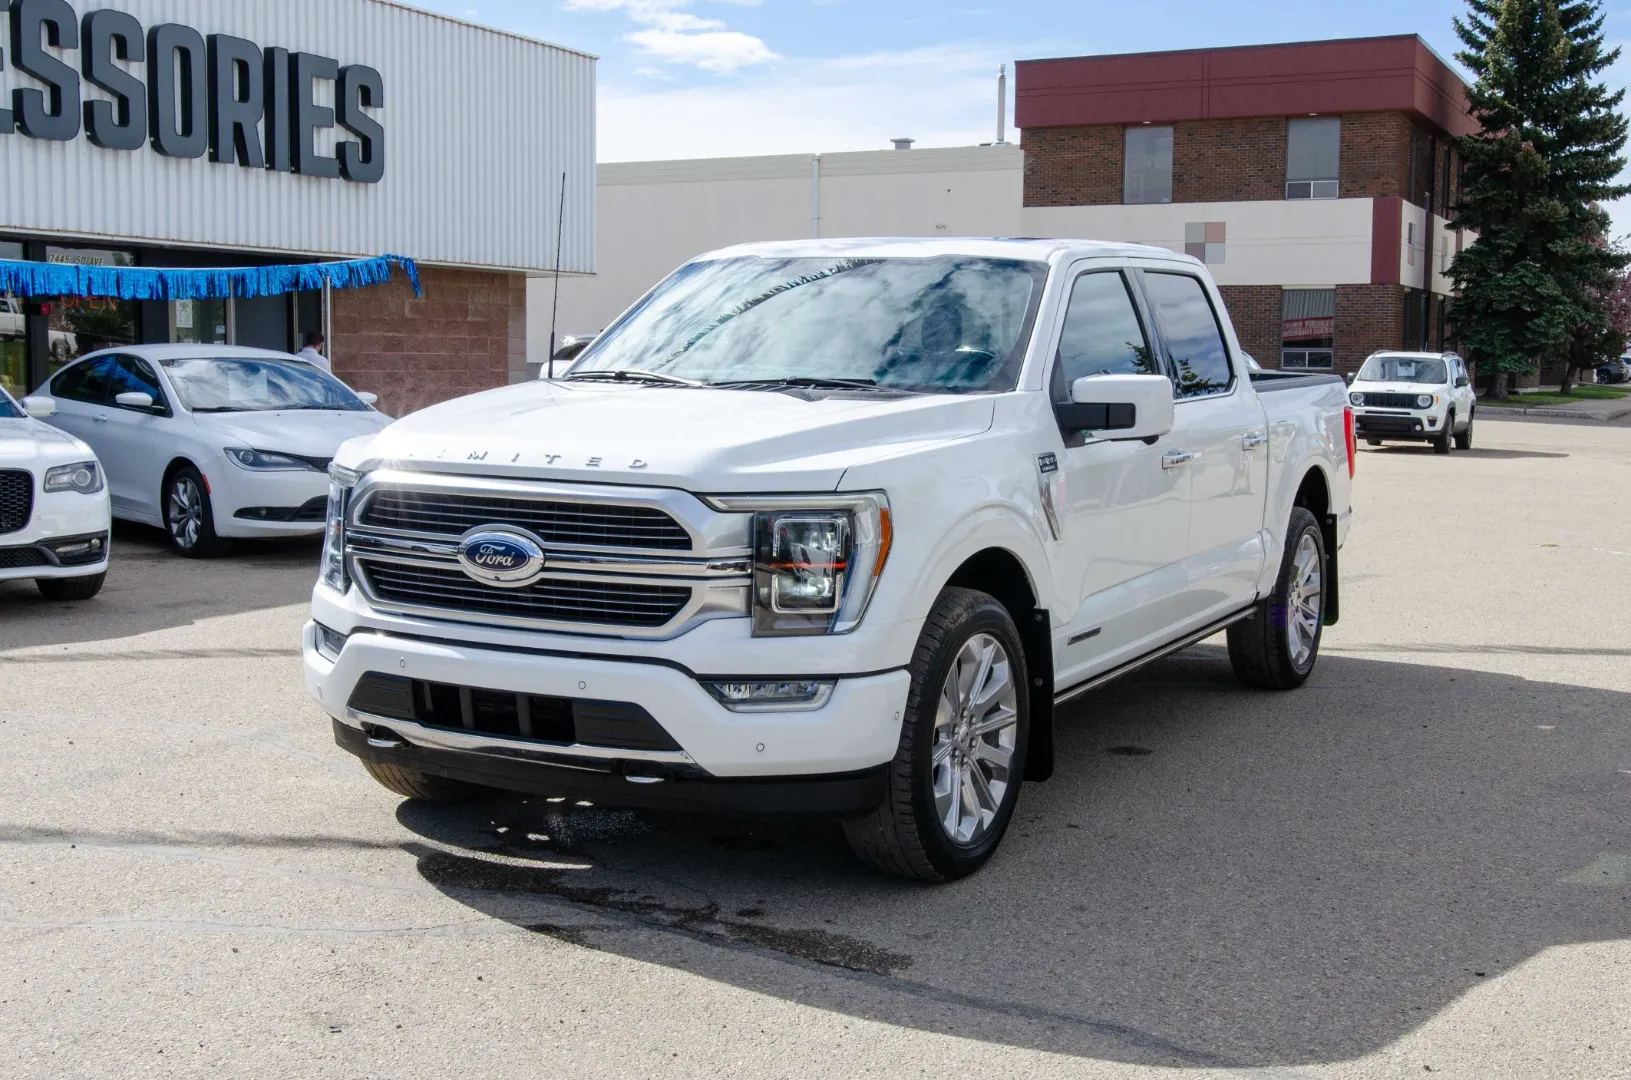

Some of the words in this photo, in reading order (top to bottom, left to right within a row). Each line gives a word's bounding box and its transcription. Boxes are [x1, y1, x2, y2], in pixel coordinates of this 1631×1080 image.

[0, 0, 384, 184] SSORIES
[50, 254, 70, 264] 7445
[89, 256, 104, 266] AVE
[475, 543, 516, 567] Ford
